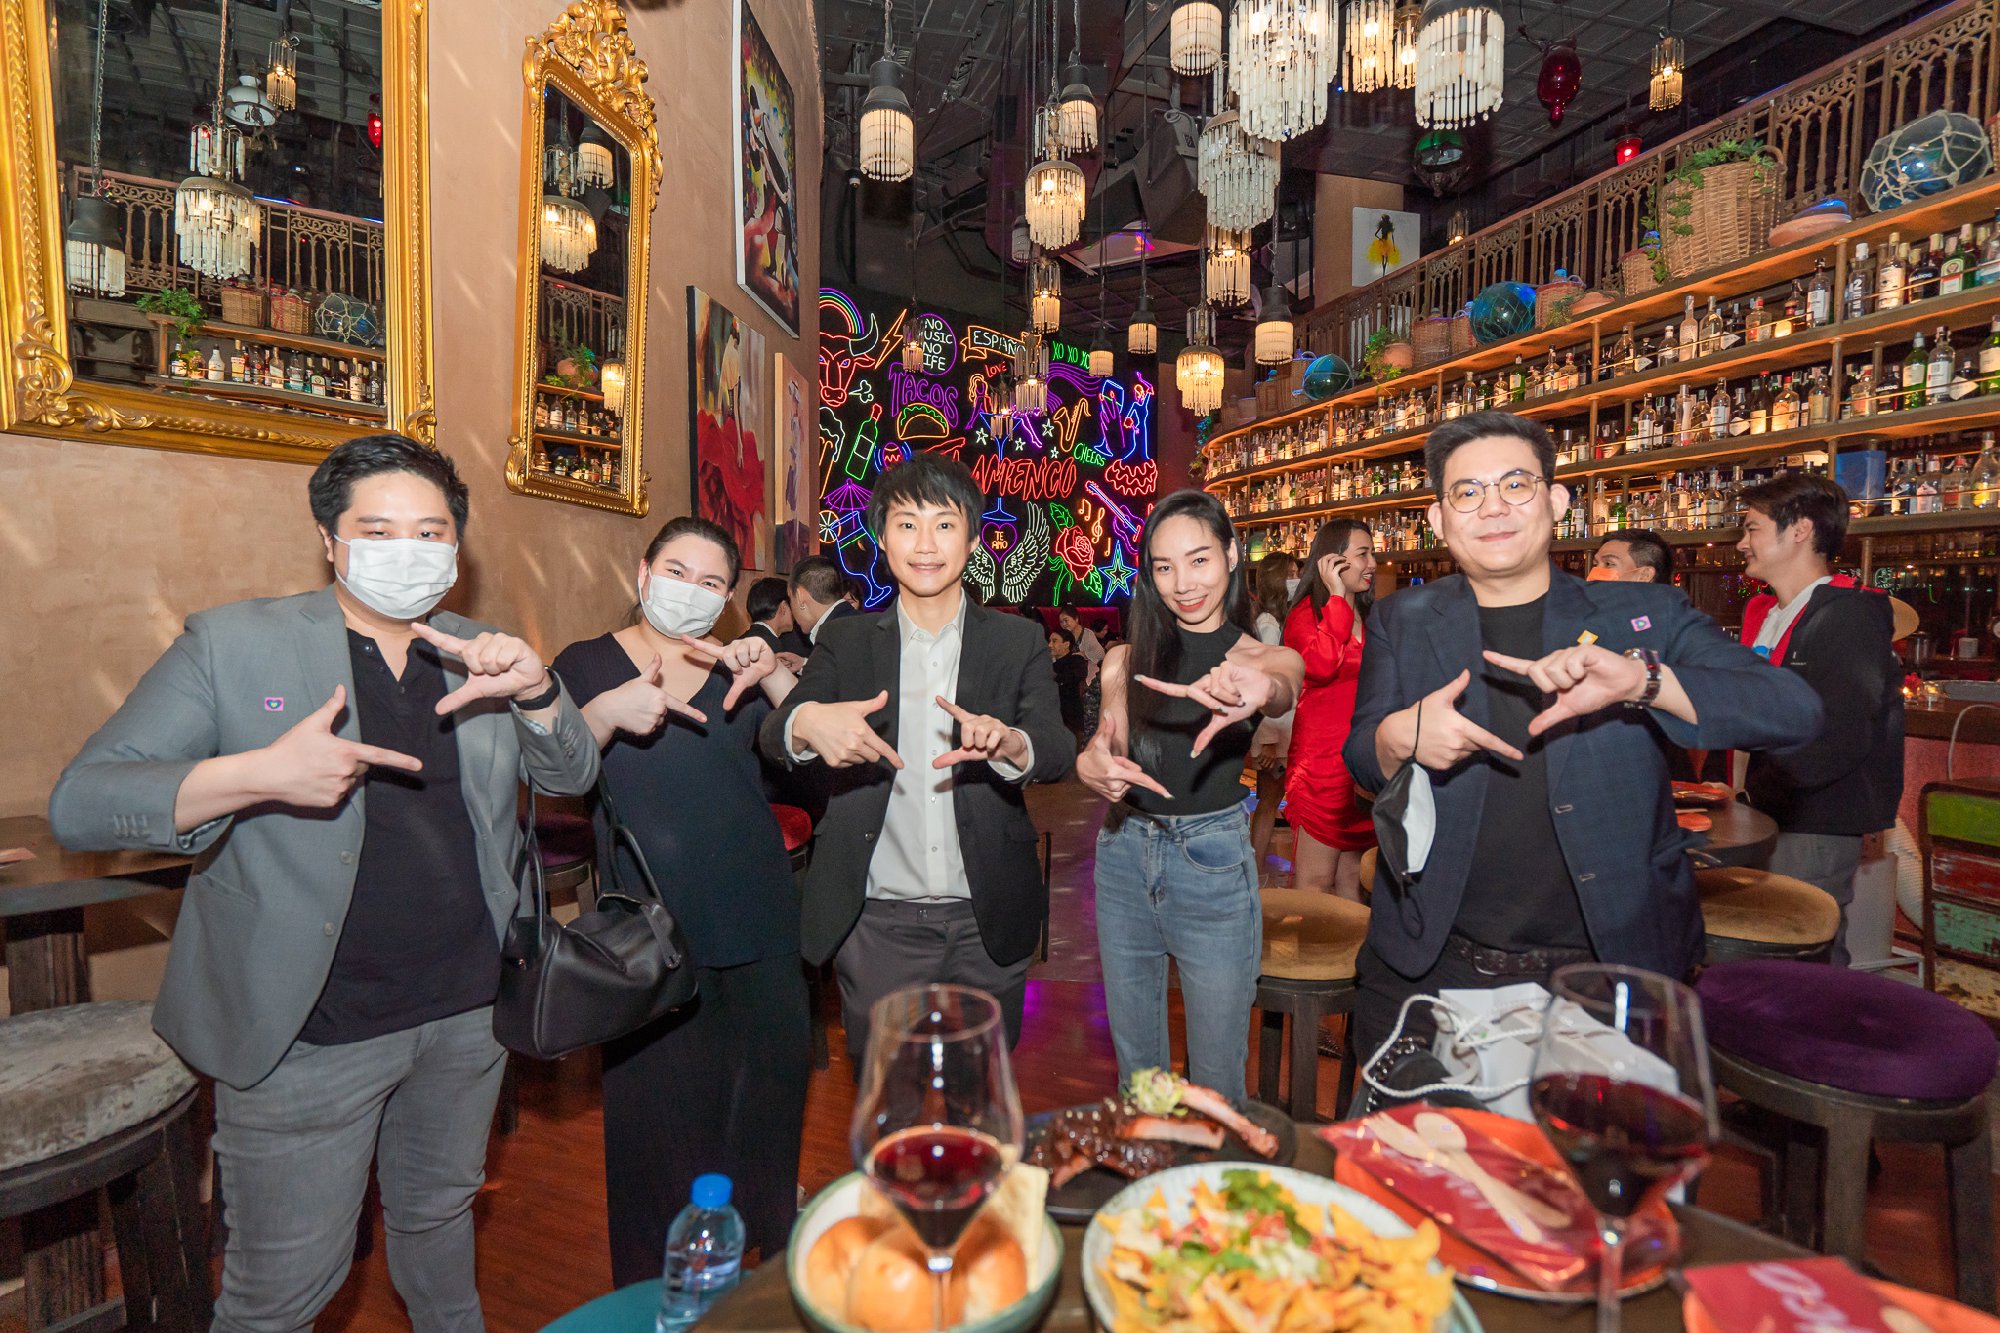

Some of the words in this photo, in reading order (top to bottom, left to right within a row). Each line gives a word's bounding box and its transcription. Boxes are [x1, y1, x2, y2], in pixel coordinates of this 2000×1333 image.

[925, 318, 943, 331] NO
[919, 330, 953, 344] USIC
[922, 341, 942, 355] NO
[1052, 341, 1065, 359] XO
[1067, 345, 1079, 363] XO
[922, 353, 946, 371] IFE
[984, 361, 1007, 378] LOVE
[888, 361, 959, 428] TACOS
[1073, 442, 1107, 467] CHEERS
[994, 530, 1004, 540] TE
